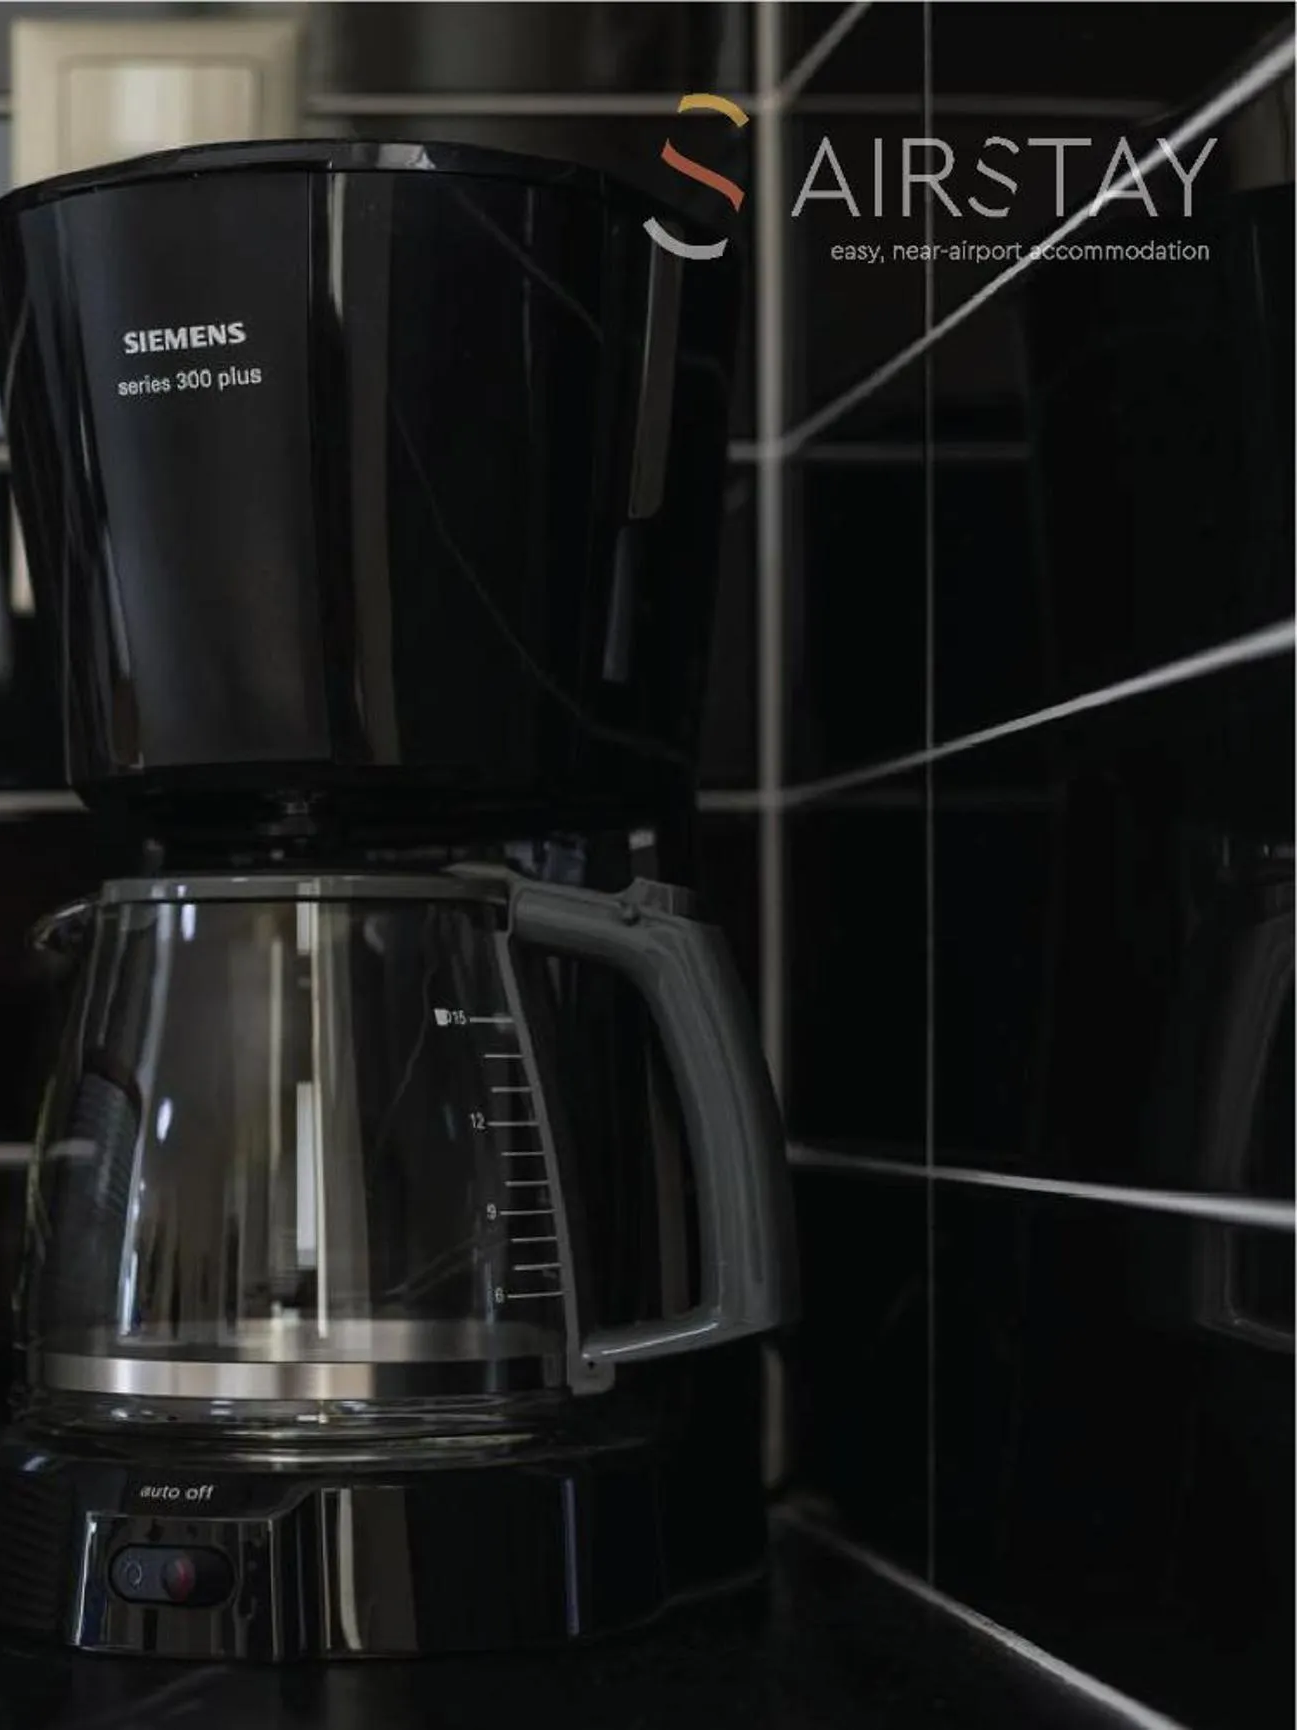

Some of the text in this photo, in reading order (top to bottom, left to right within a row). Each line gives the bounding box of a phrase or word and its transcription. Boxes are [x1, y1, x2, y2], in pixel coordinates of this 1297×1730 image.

[123, 322, 247, 354] SIEMENS
[117, 366, 262, 396] series 300 plus
[469, 1112, 486, 1129] 12
[140, 1484, 214, 1503] auto off
